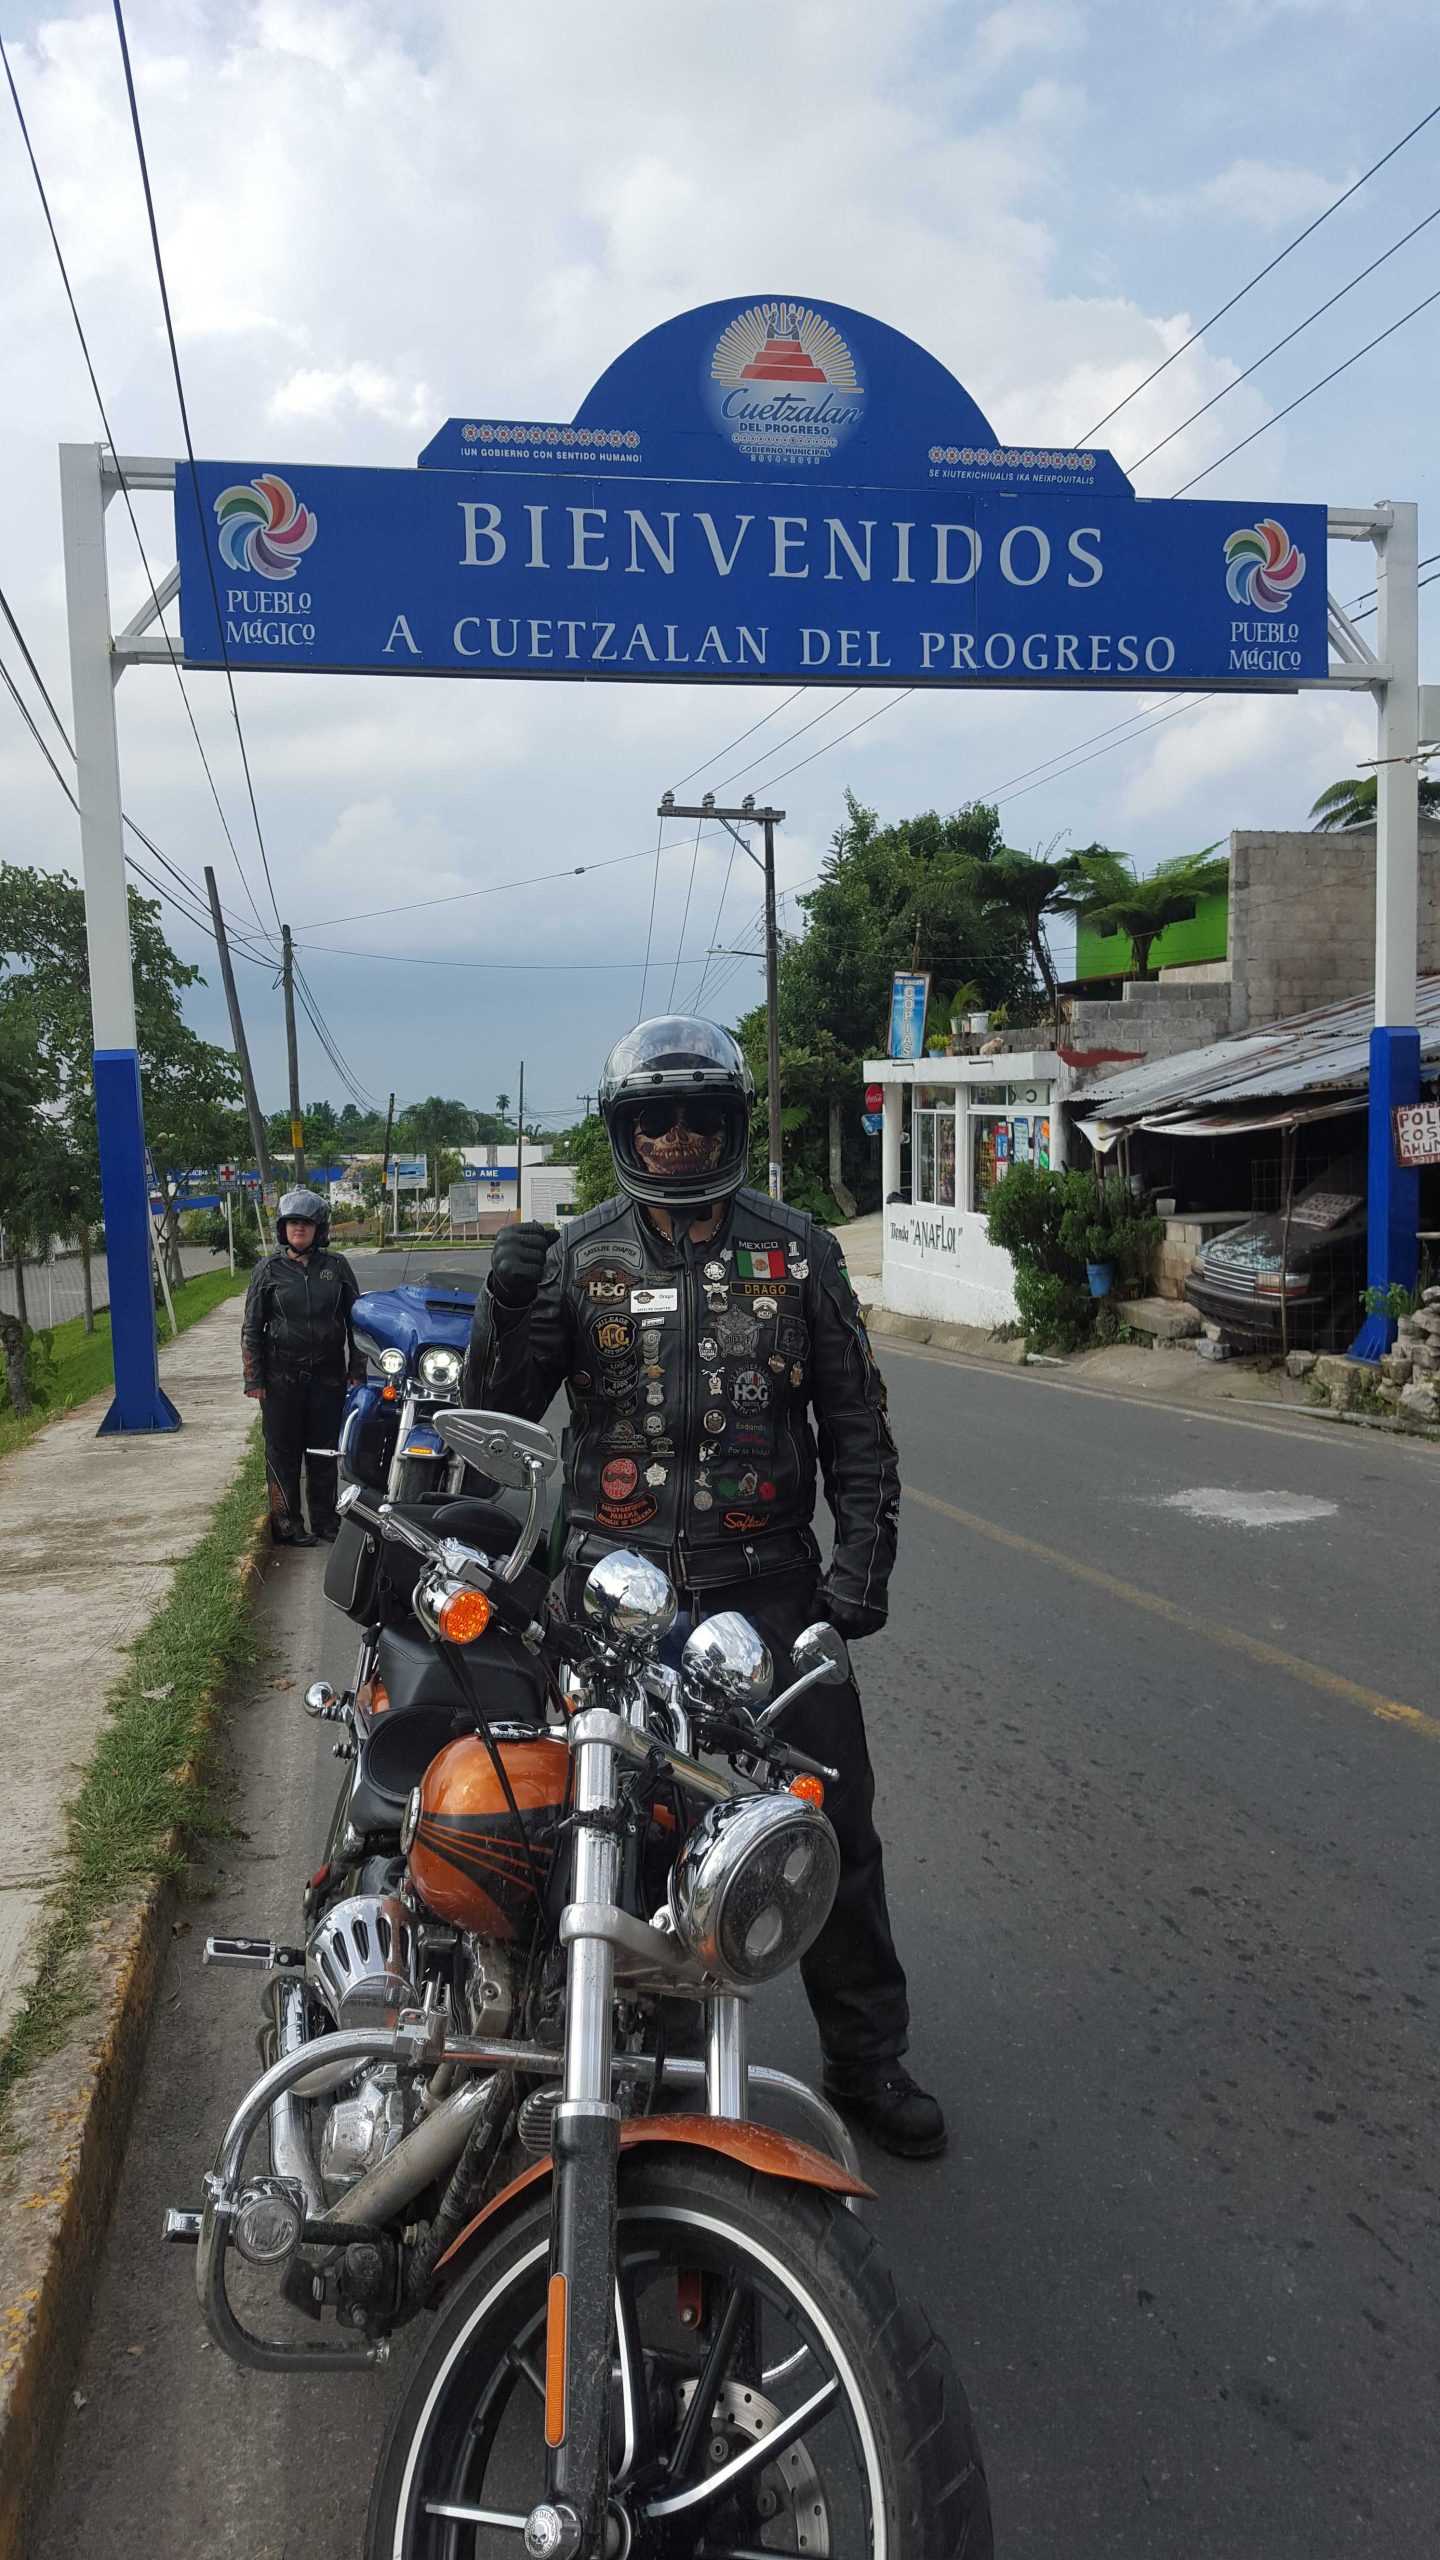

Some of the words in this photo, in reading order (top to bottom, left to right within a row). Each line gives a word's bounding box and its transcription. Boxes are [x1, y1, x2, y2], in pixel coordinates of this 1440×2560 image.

[721, 388, 863, 425] Cuetzalan
[739, 422, 762, 432] DEL
[765, 423, 830, 435] PROGRESO
[481, 448, 530, 458] GOBIERNO
[533, 450, 552, 459] CON
[556, 451, 596, 460] SENTIDO
[600, 453, 642, 463] HUMANO!
[740, 445, 783, 454] GOBIERNO
[785, 447, 831, 457] MUNICIPAL
[929, 469, 940, 477] SE
[1017, 474, 1030, 482] IKA
[457, 502, 1103, 588] BIENVENIDOS
[226, 590, 312, 614] PUEBLO
[1230, 621, 1299, 643] PUEBLO
[383, 615, 422, 654] A
[453, 617, 769, 664] CUETZALAN
[800, 629, 891, 667] DEL
[919, 632, 1175, 673] PROGRESO
[902, 985, 915, 1058] COPIAS
[1401, 1126, 1440, 1142] COS
[612, 1245, 637, 1257] CHAPTER
[739, 1240, 779, 1250] MEXICO
[744, 1284, 787, 1295] DRAGO
[596, 1316, 629, 1329] MILEAGE
[723, 1512, 769, 1532] Softail
